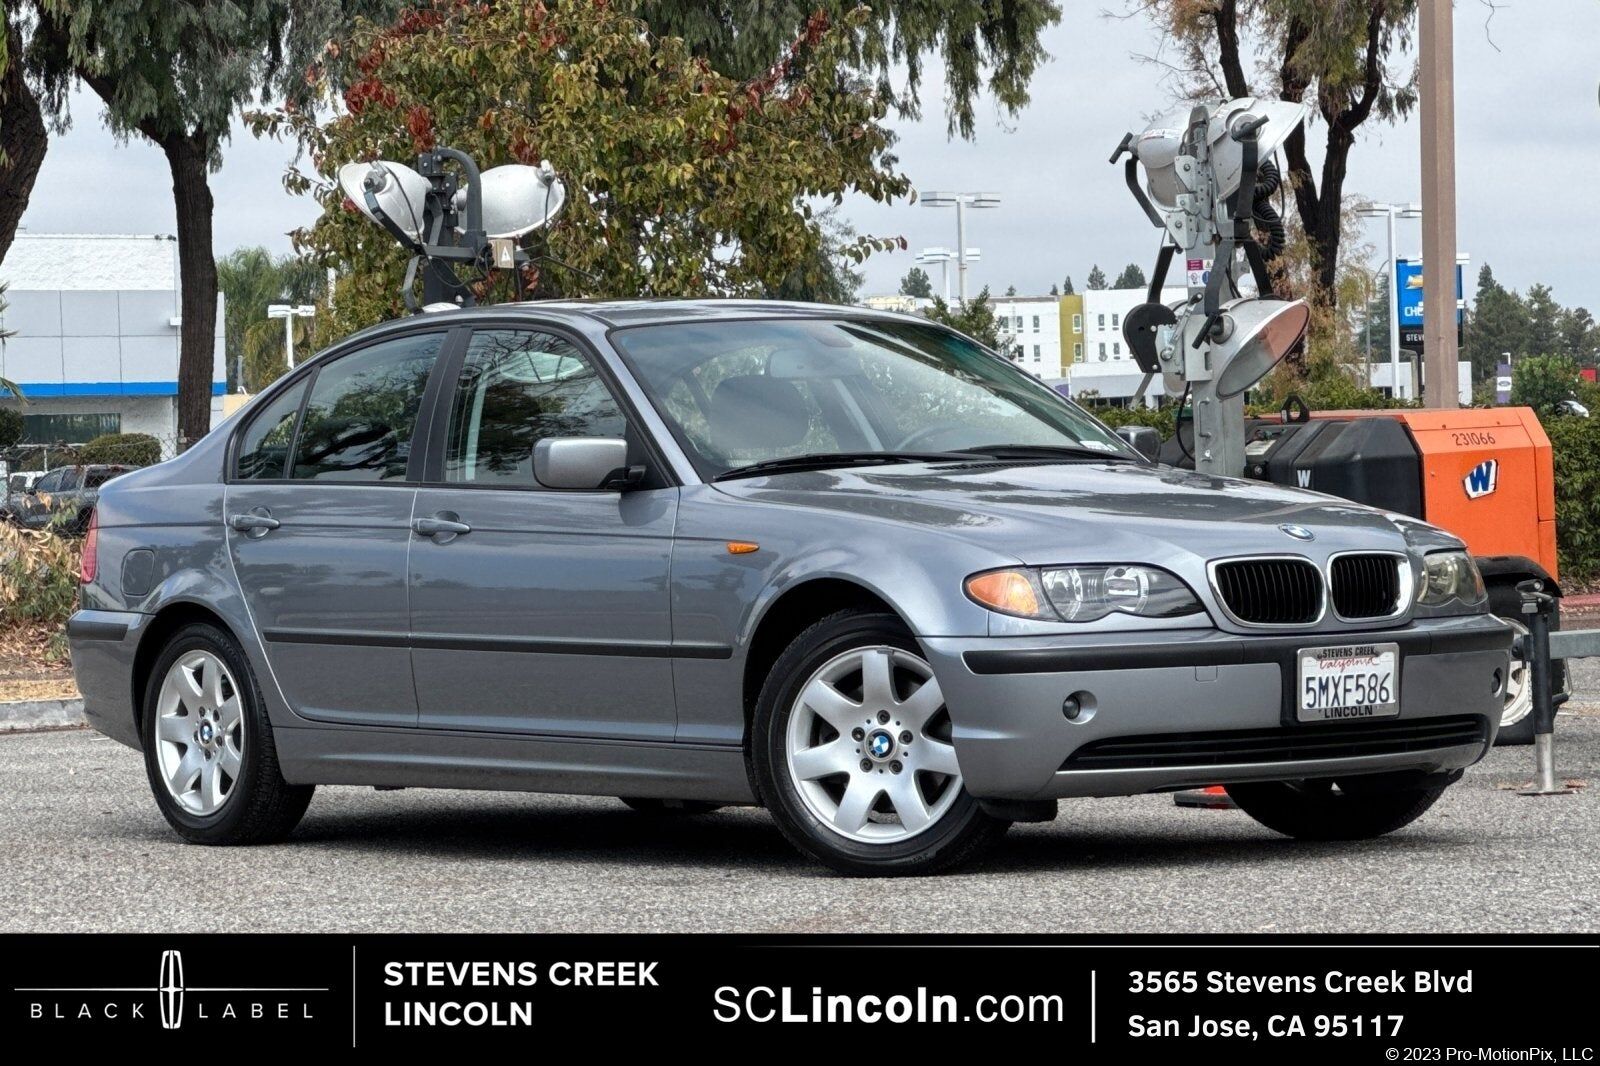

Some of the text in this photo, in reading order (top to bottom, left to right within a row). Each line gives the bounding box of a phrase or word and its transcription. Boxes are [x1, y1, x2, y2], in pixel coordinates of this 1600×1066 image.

[1451, 432, 1496, 446] 231066
[1297, 470, 1311, 488] W
[1469, 461, 1493, 493] W
[1322, 646, 1376, 659] STEVENS CREEK
[1319, 657, 1379, 673] California
[1305, 672, 1391, 708] 5MXF586
[1324, 705, 1373, 718] LINCOLN
